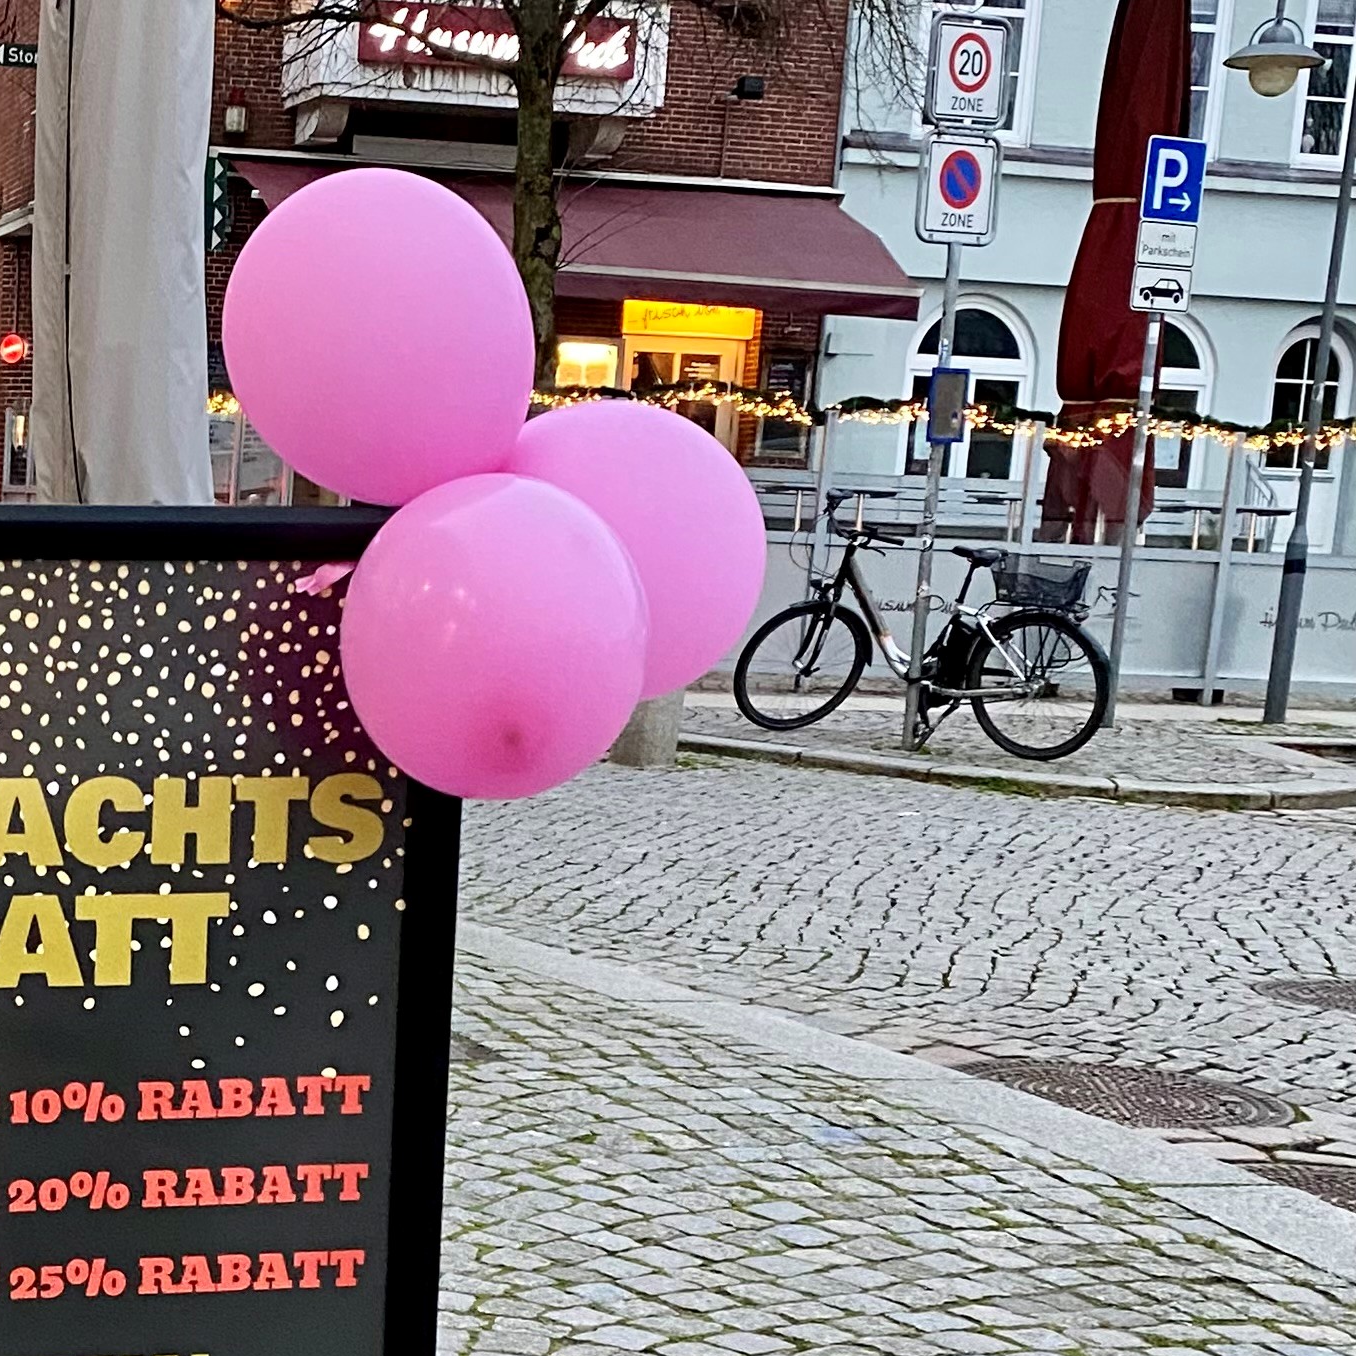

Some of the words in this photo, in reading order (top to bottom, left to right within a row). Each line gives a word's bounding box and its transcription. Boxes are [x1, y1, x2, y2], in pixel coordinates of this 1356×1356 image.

[958, 49, 983, 76] 20
[951, 96, 984, 112] ZONE
[1152, 148, 1189, 209] P
[941, 212, 975, 228] ZONE
[1142, 244, 1191, 258] Parkschein
[10, 1082, 125, 1124] 10%
[137, 1075, 371, 1121] RABATT
[8, 1171, 130, 1213] 20%
[142, 1163, 369, 1208] RABATT
[9, 1258, 127, 1301] 25%
[138, 1250, 365, 1296] RABATT
